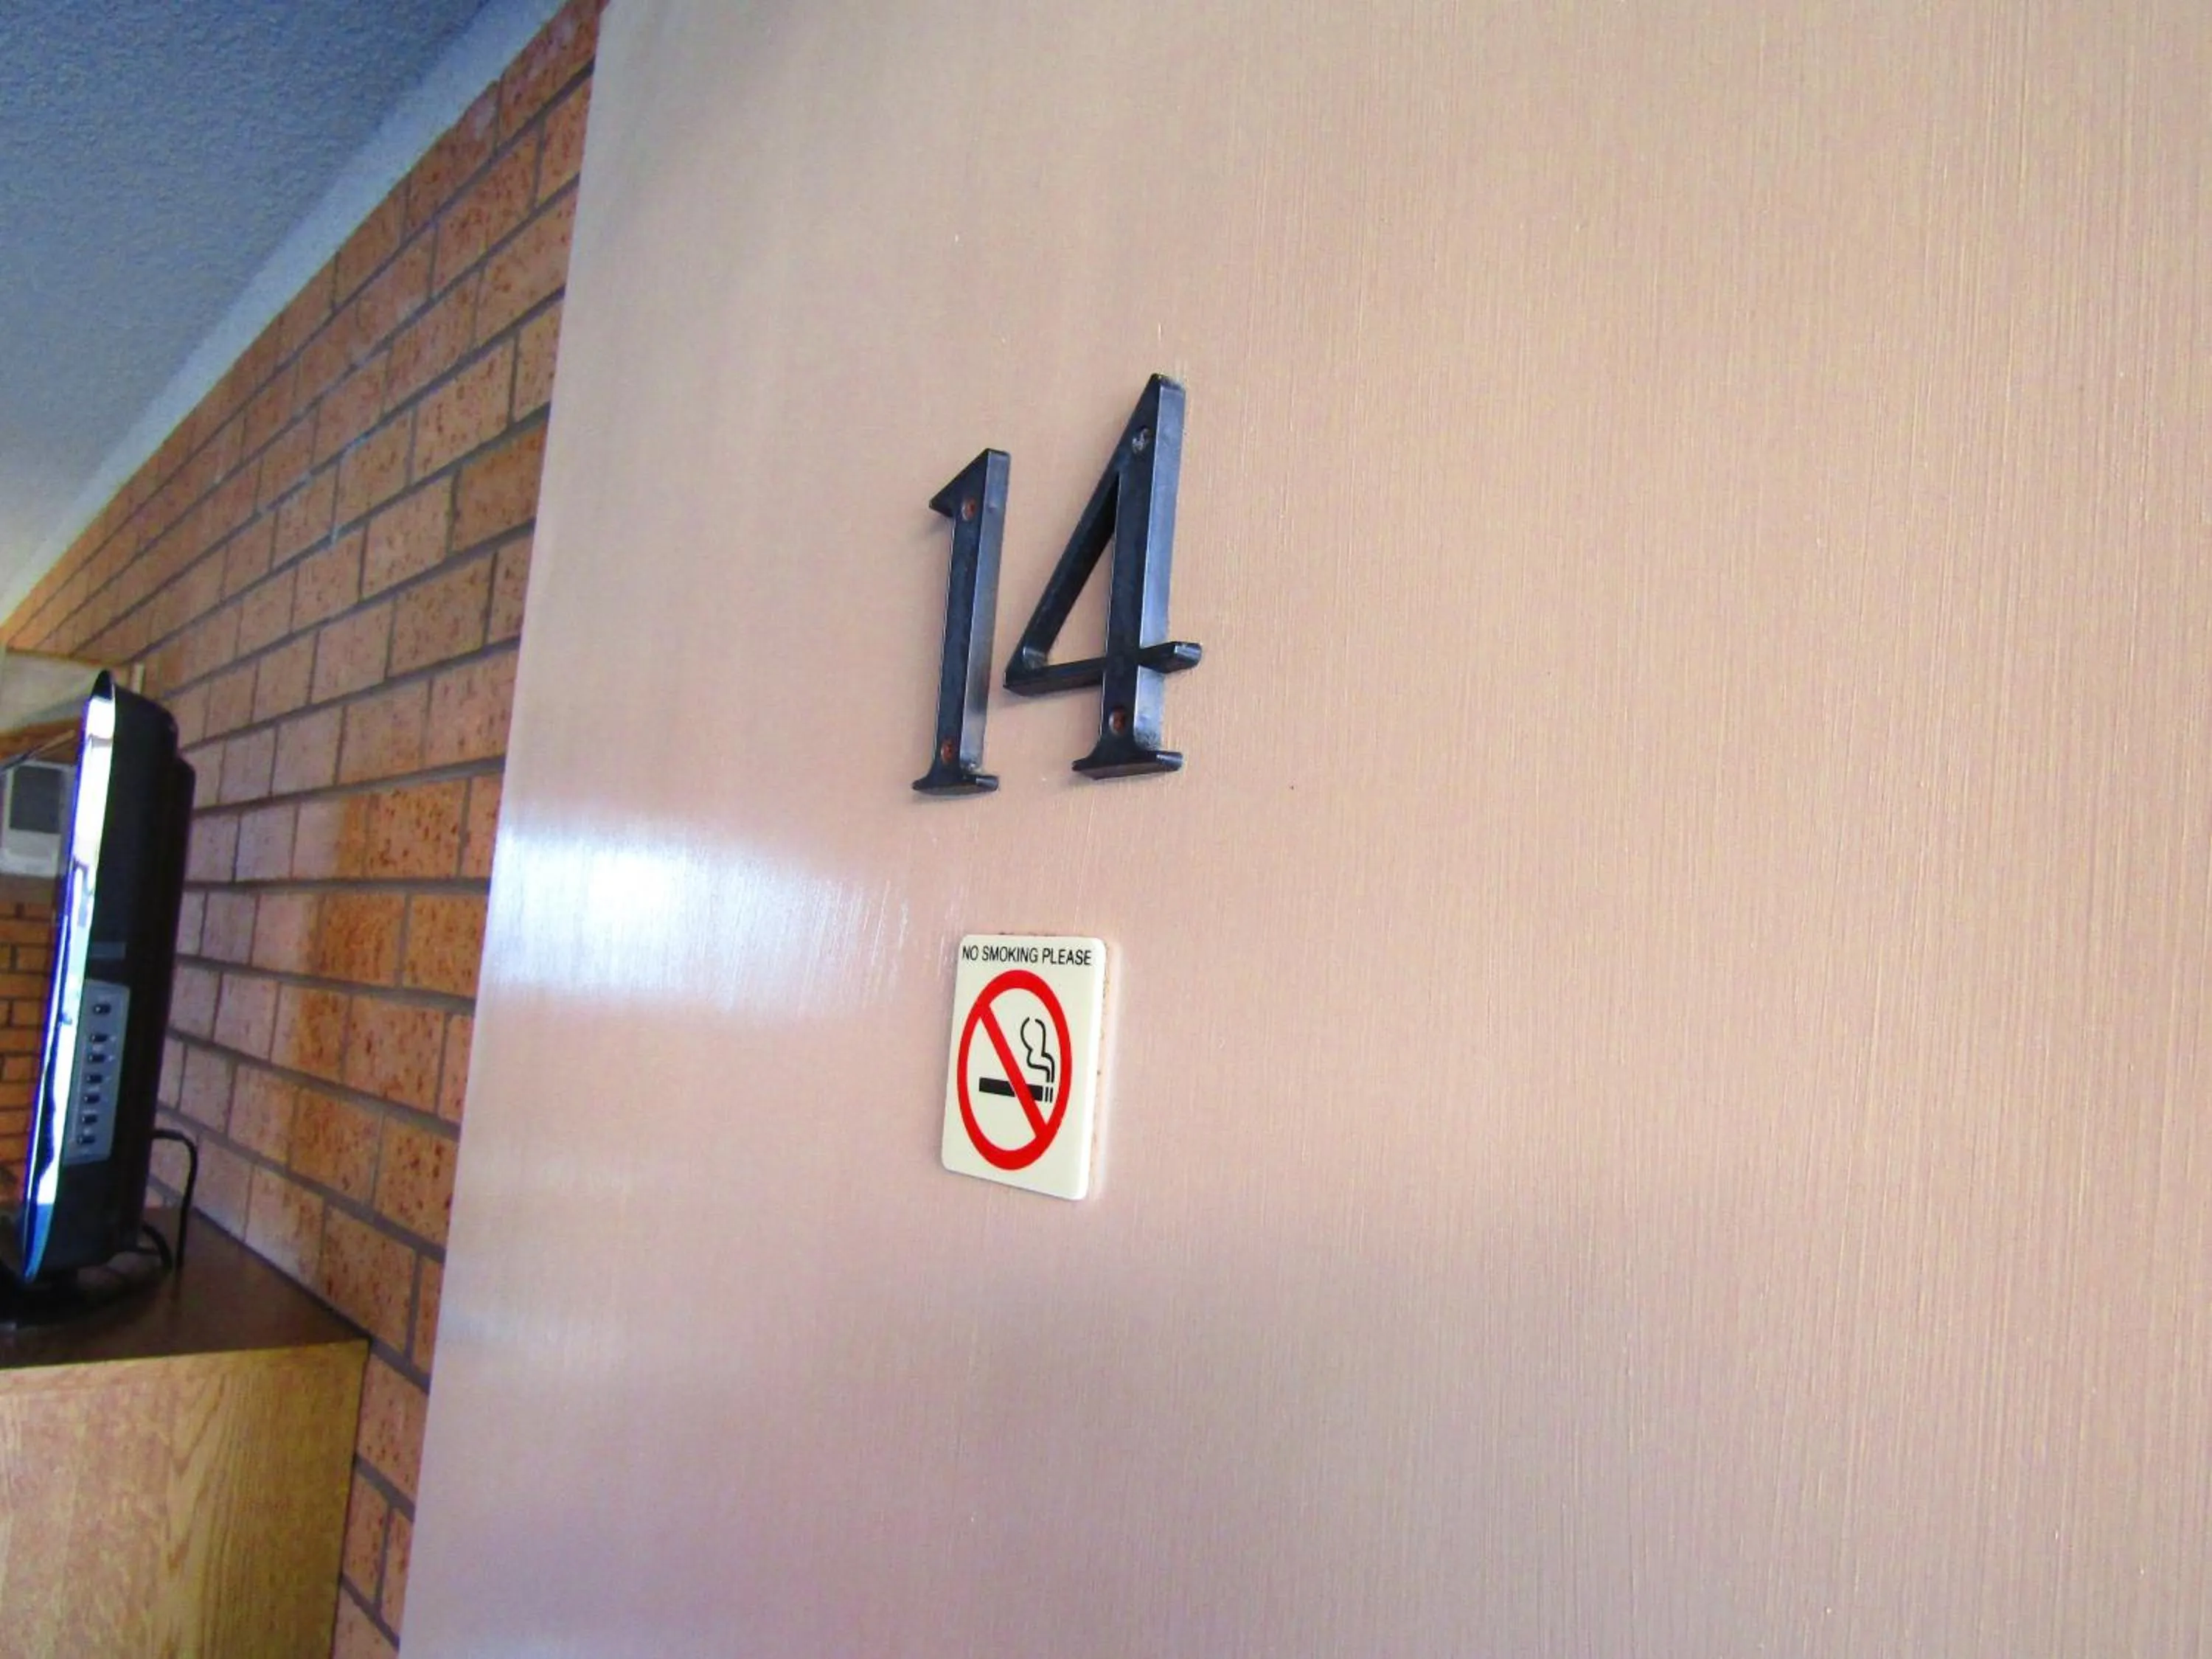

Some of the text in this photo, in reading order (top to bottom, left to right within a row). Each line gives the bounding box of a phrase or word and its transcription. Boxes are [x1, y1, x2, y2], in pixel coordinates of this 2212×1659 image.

[912, 372, 1203, 796] 14
[962, 945, 1092, 966] NO SMOKING PLEASE
